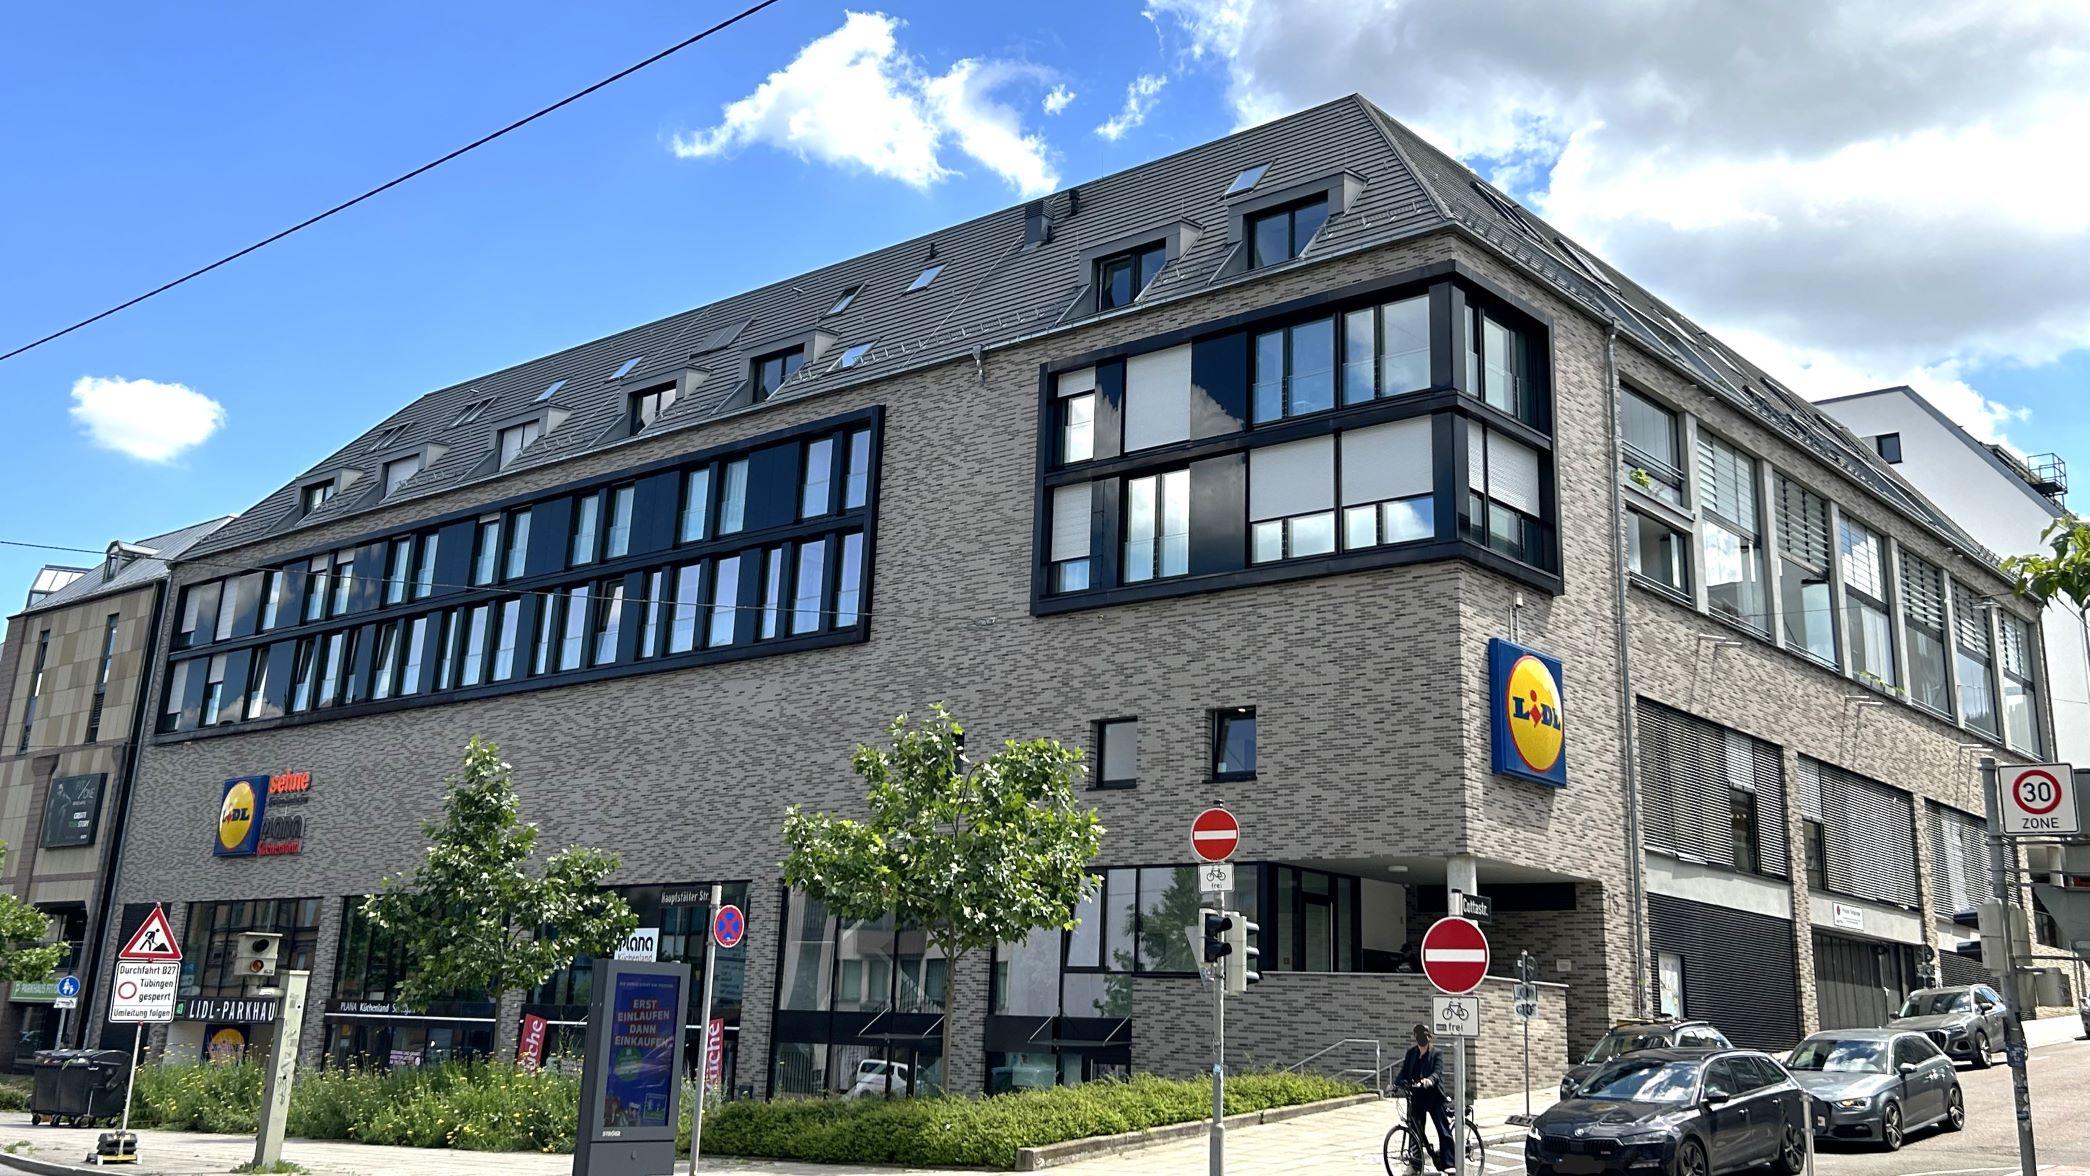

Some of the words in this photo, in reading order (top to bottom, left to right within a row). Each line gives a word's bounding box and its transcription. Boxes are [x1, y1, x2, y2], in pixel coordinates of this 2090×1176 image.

[2022, 781, 2051, 802] 30
[2021, 817, 2060, 829] ZONE
[1463, 897, 1489, 916] Cottastr.
[120, 965, 160, 975] Durchfahrt
[162, 966, 177, 975] B27
[140, 978, 174, 990] Tübingen
[138, 993, 171, 1003] gesperrt
[340, 1002, 357, 1012] PLANA
[360, 1002, 390, 1013] Küchenland
[633, 999, 657, 1010] ERST
[113, 1008, 148, 1018] Umleitung
[149, 1009, 171, 1018] folgen
[189, 1000, 276, 1021] LIDL-PARKHAU
[617, 1010, 670, 1022] EINLAUFEN
[629, 1024, 657, 1034] DANN
[1449, 1022, 1463, 1032] frei
